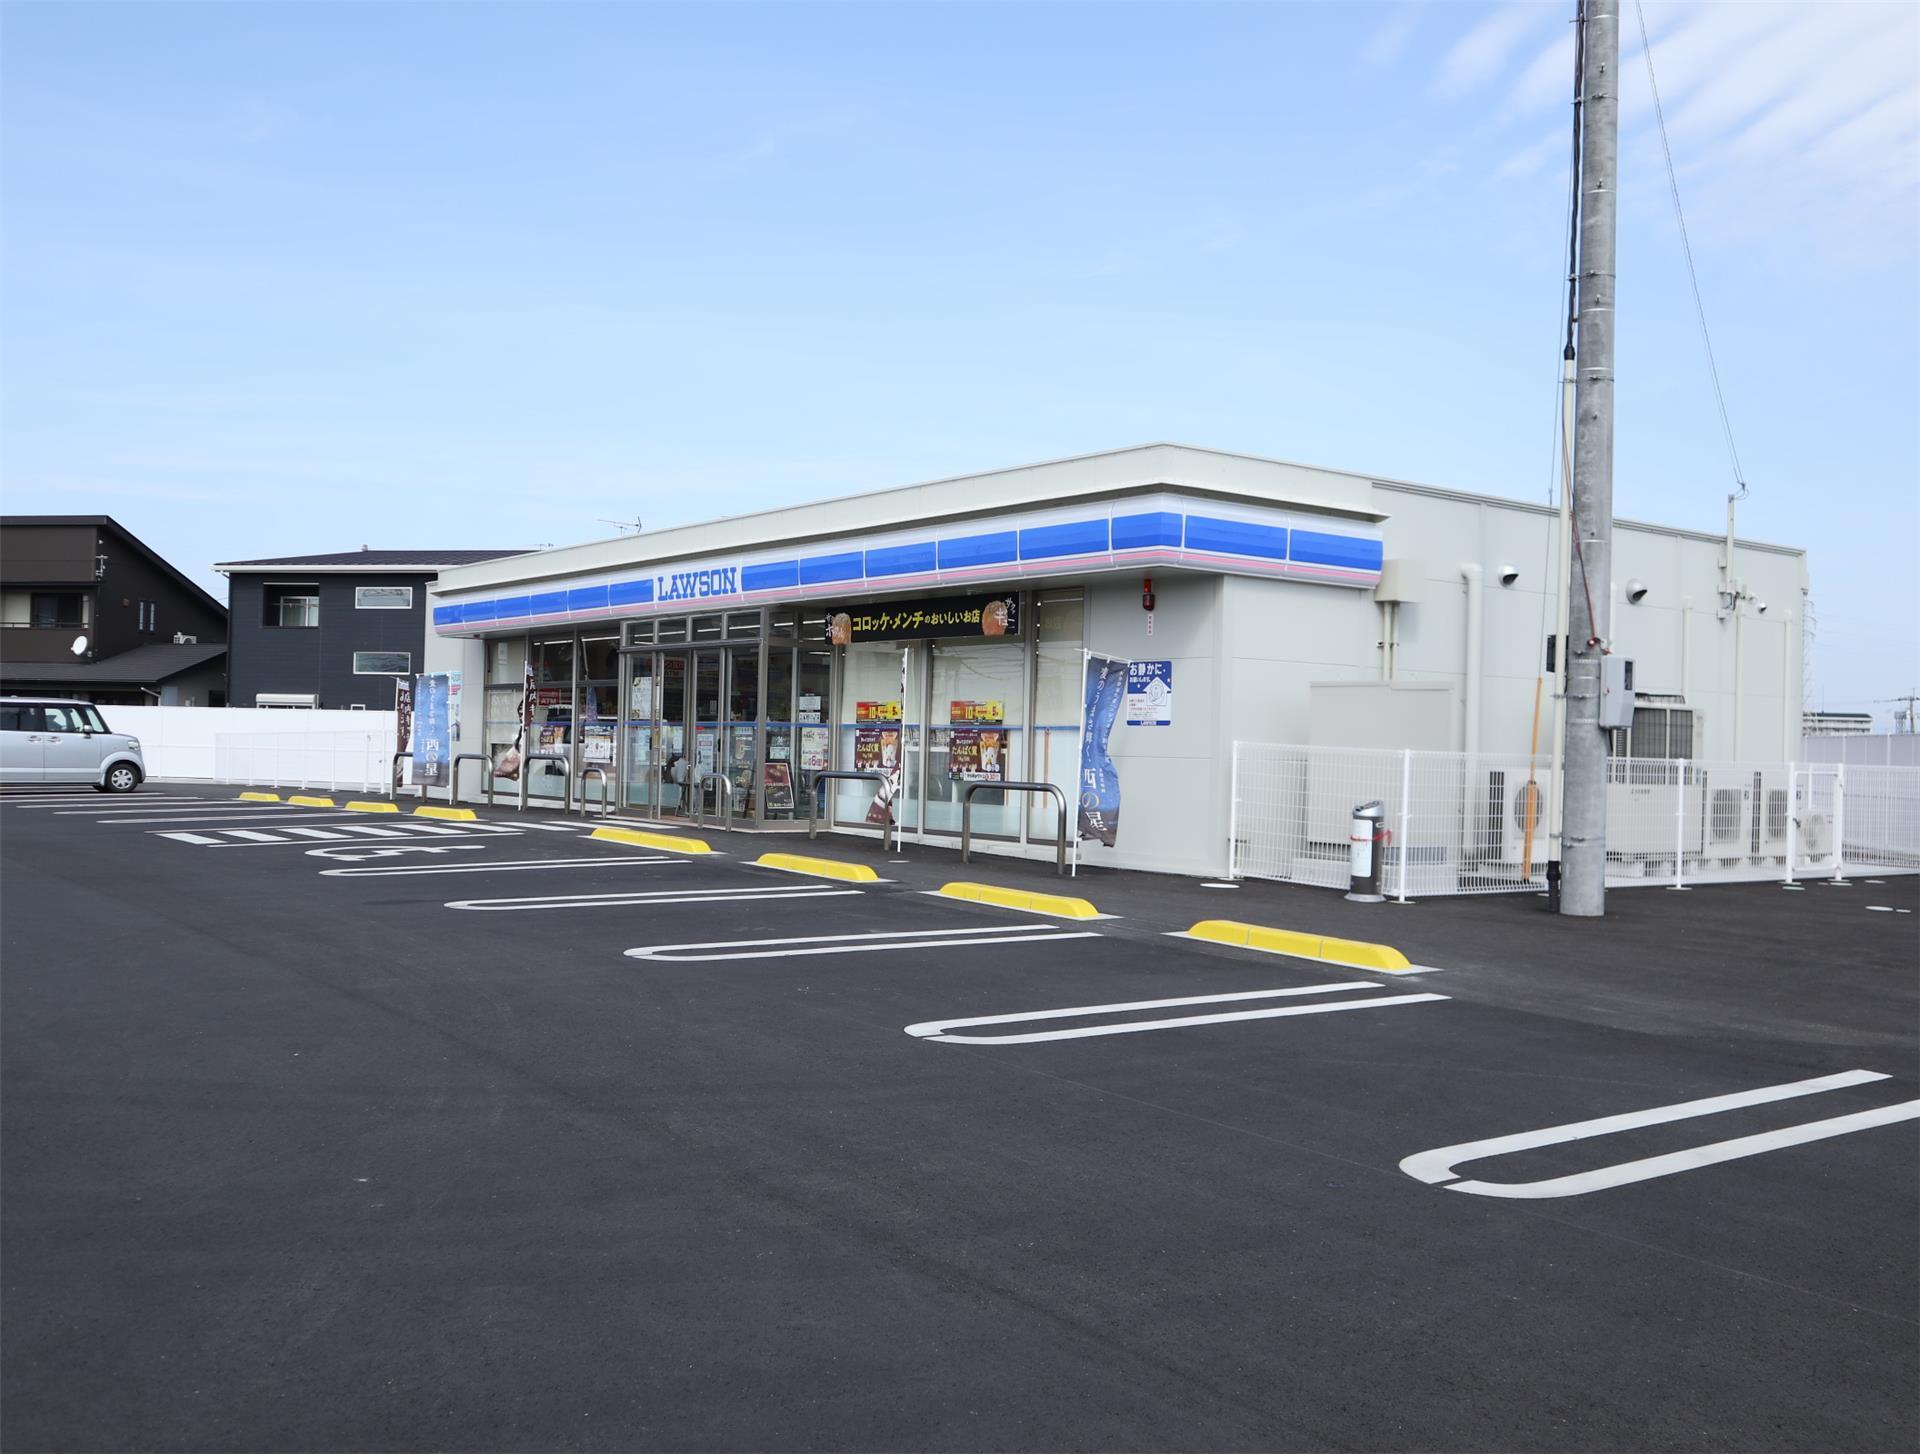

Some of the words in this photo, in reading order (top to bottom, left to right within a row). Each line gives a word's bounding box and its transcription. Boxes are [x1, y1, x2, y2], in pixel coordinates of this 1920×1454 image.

[658, 567, 737, 602] LAWSON
[853, 609, 980, 632] コロッケ・メンチのおいしいお店
[1129, 663, 1162, 676] お静かに
[540, 697, 557, 705] ATM
